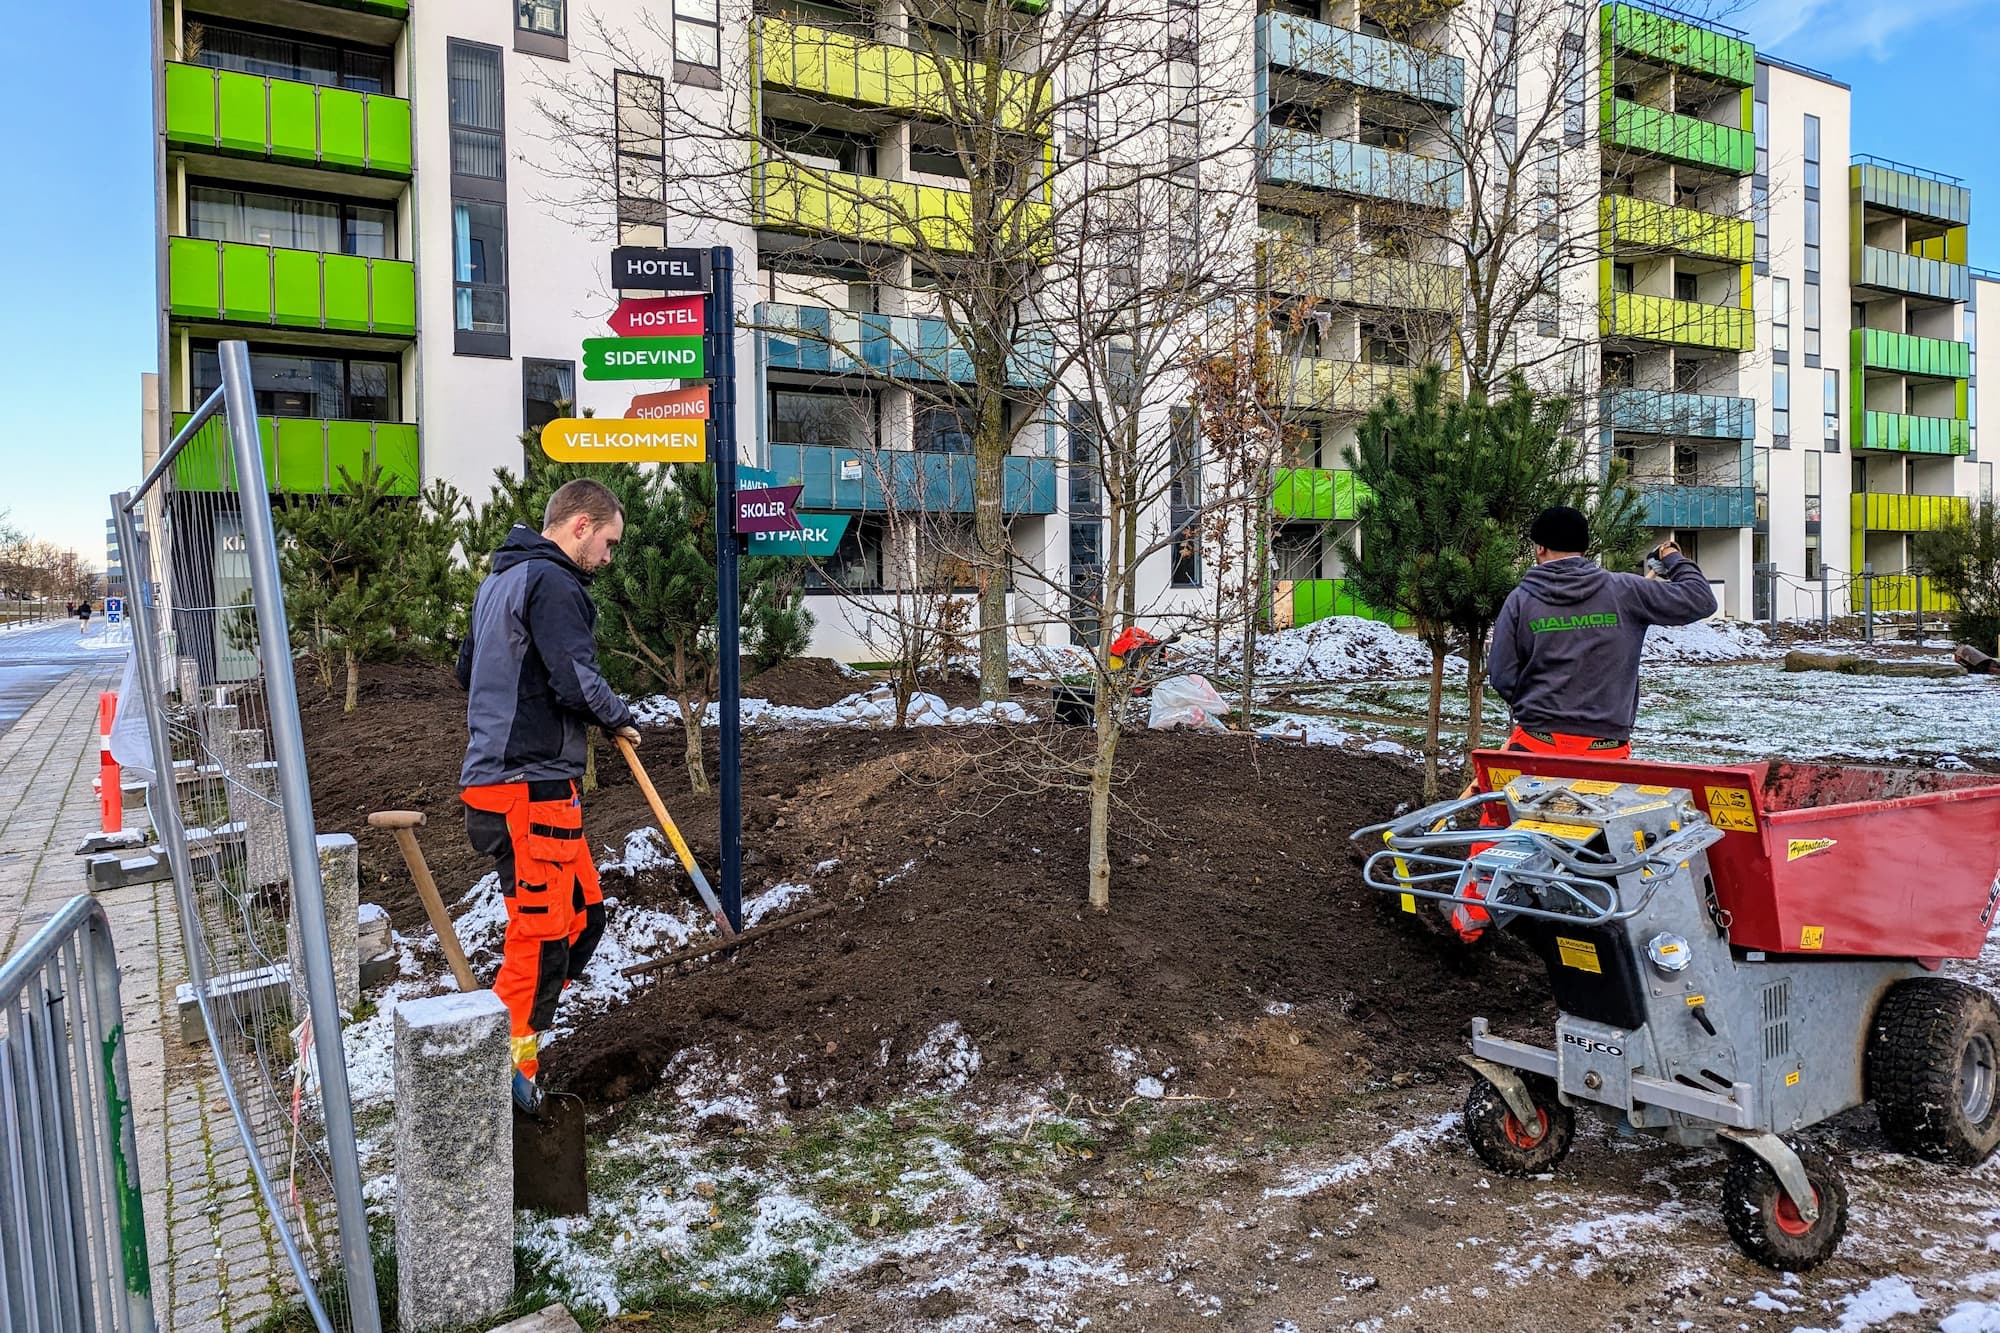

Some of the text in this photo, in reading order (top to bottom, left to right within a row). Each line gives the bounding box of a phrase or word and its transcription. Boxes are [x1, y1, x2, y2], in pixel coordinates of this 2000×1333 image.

[627, 259, 694, 277] HOTEL
[629, 308, 698, 327] HOSTEL
[604, 350, 697, 366] SIDEVIND
[636, 400, 705, 419] SHOPPING
[564, 432, 699, 448] VELKOMMEN
[740, 501, 786, 518] SKOLER
[755, 528, 829, 542] BYPARK
[1528, 613, 1618, 632] MALMOS
